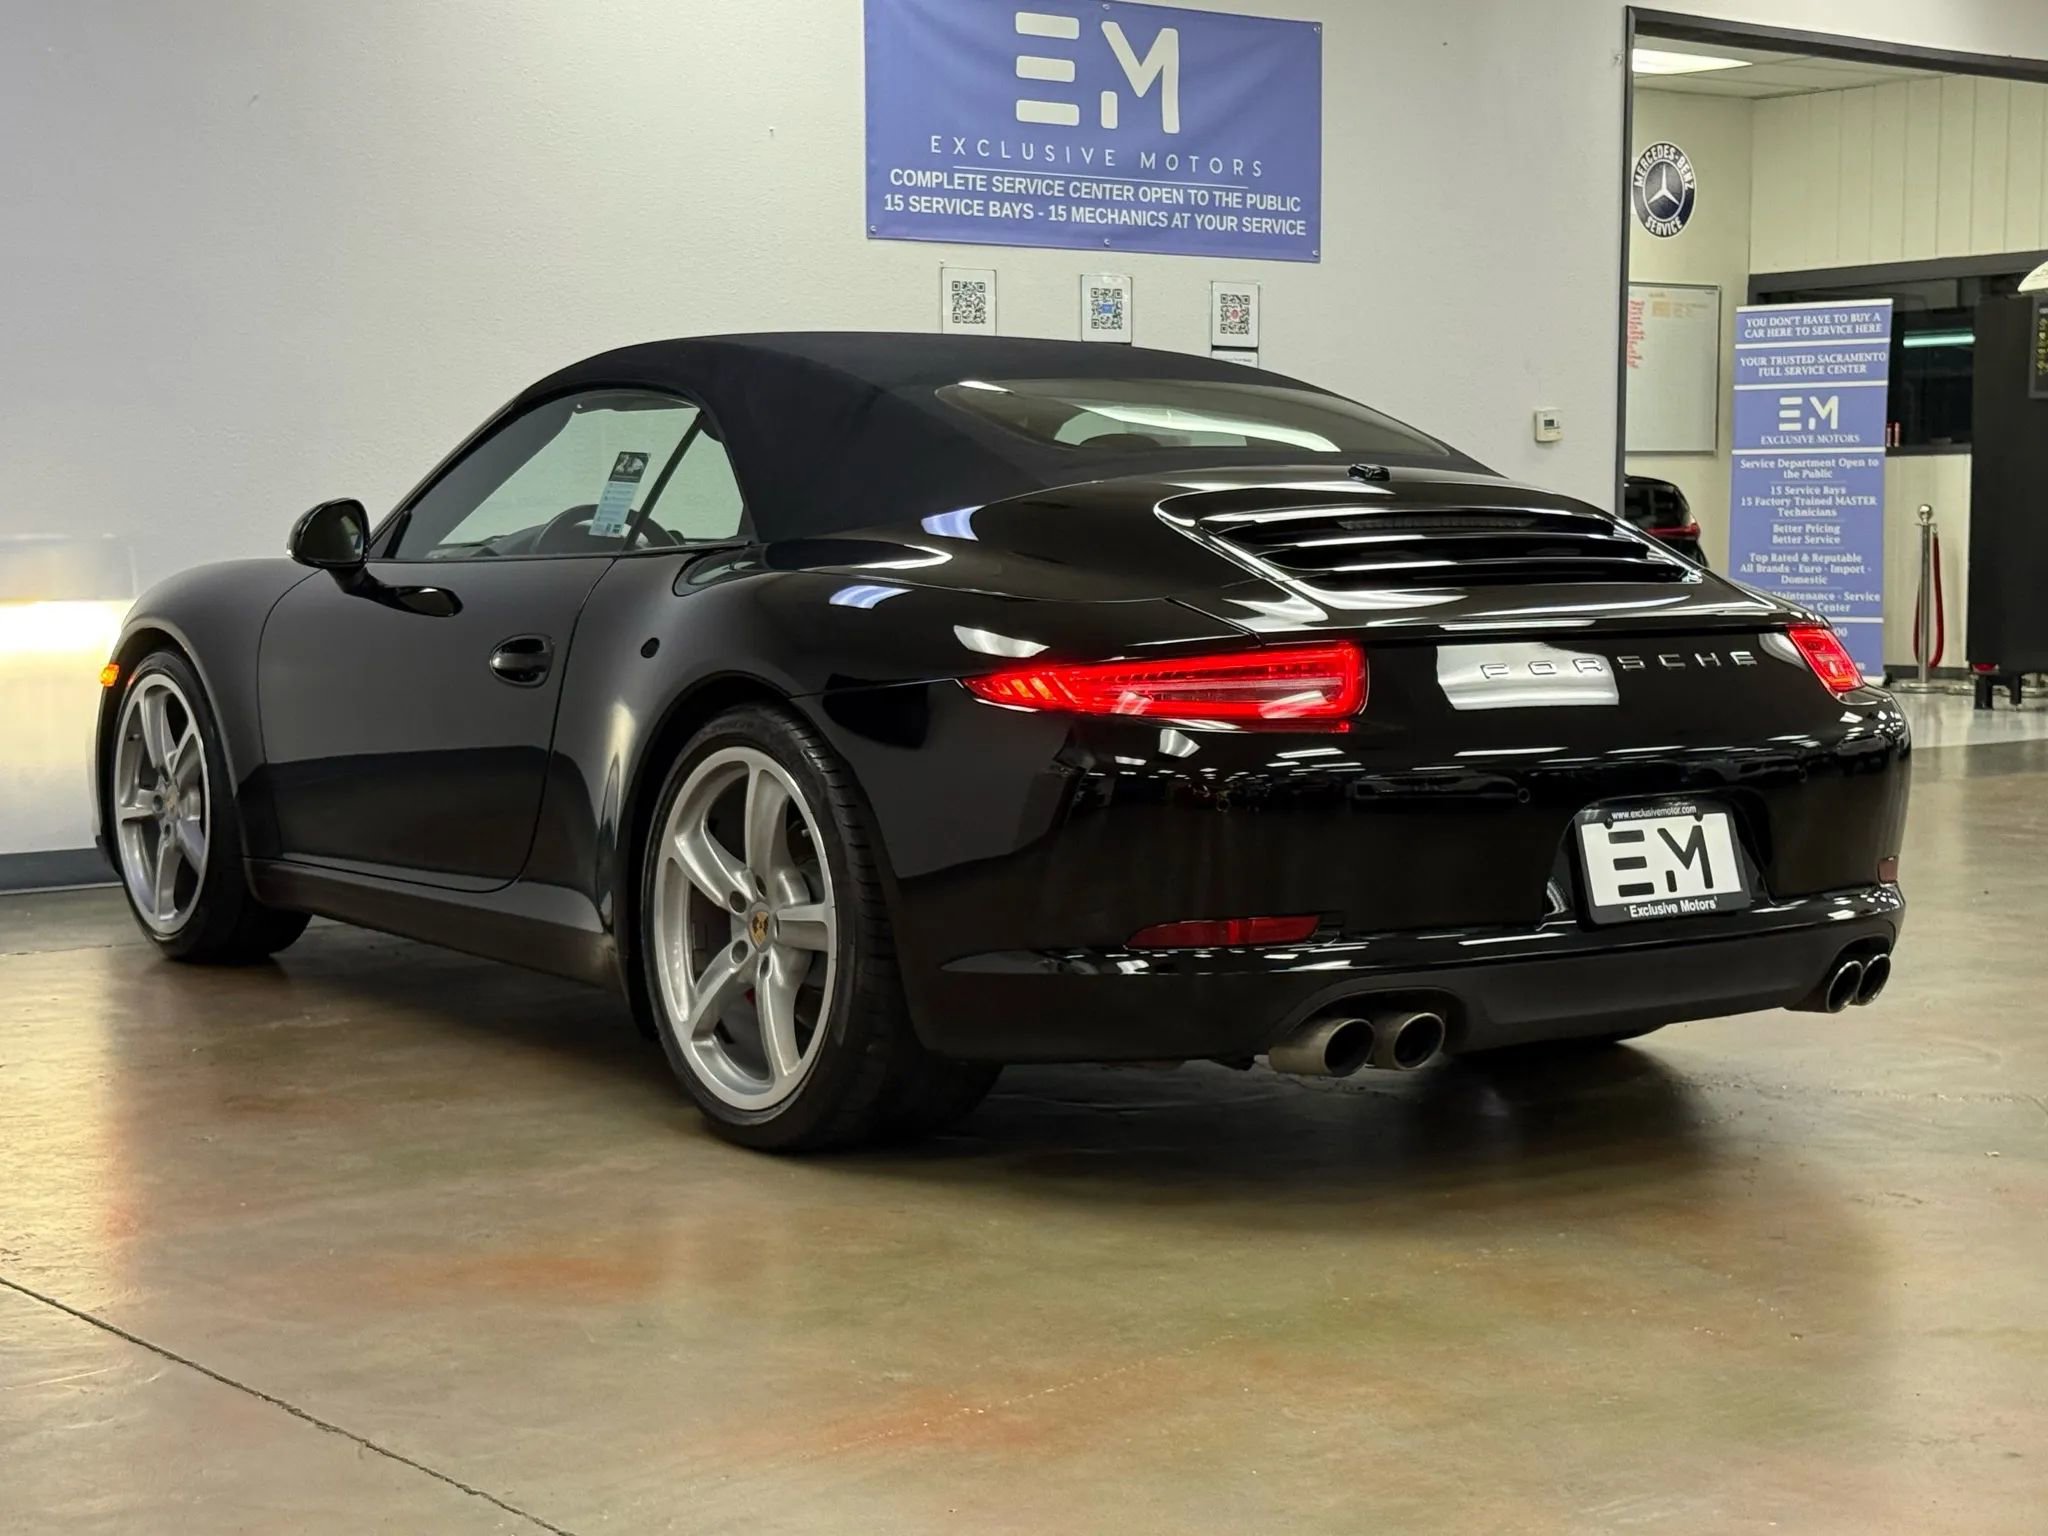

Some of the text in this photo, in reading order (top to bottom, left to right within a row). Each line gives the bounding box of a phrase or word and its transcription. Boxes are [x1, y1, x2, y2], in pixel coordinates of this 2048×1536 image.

[1015, 12, 1180, 134] EM
[931, 135, 1262, 177] EXCLUSIVE MOTORS
[1633, 144, 1694, 190] MERCEDES-BENZ
[890, 168, 1301, 212] COMPLETE SERVICE CENTER OPEN TO THE PUBLIC
[884, 194, 904, 211] 15
[908, 195, 984, 216] SERVICE
[989, 201, 1034, 220] BAYS
[1048, 205, 1066, 222] 15
[1071, 206, 1168, 228] MECHANICS
[1170, 213, 1191, 229] AT
[1194, 214, 1238, 232] YOUR
[1242, 217, 1306, 236] SERVICE
[1645, 216, 1682, 236] SERVICE
[1746, 312, 1880, 328] YOU DON'T HAVE TO BUY A
[1744, 324, 1882, 338] CAR HERE TO SERVICE HERE
[1740, 352, 1886, 367] YOUR TRUSTED SACRAMENTO
[1758, 364, 1867, 376] FULL SERVICE CENTER
[1779, 395, 1839, 431] EM
[1760, 434, 1860, 446] EXCLUSIVE MOTORS
[1740, 458, 1879, 470] Service Department Open to
[1784, 469, 1832, 478] the Public
[1771, 486, 1846, 496] 15 Service Bays
[1754, 497, 1792, 508] Factory
[1794, 496, 1833, 506] Trained
[1836, 496, 1878, 506] MASTER
[1778, 508, 1838, 517] Technicians
[1773, 524, 1841, 534] Better Pricing
[1772, 535, 1841, 544] Better Service
[1749, 553, 1768, 564] Top
[1771, 553, 1799, 562] Rated
[1812, 553, 1862, 564] Reputable
[1740, 564, 1754, 573] All
[1756, 564, 1790, 573] Brands
[1798, 564, 1822, 574] Euro
[1830, 564, 1865, 574] Import
[1781, 575, 1828, 584] Domestic
[1844, 592, 1880, 602] Service
[1817, 603, 1851, 612] Center
[1480, 651, 1758, 679] PORSCHE
[1612, 805, 1697, 820] www.exclusivemotor.com
[1608, 825, 1714, 898] EM
[1630, 901, 1678, 918] Exclusive
